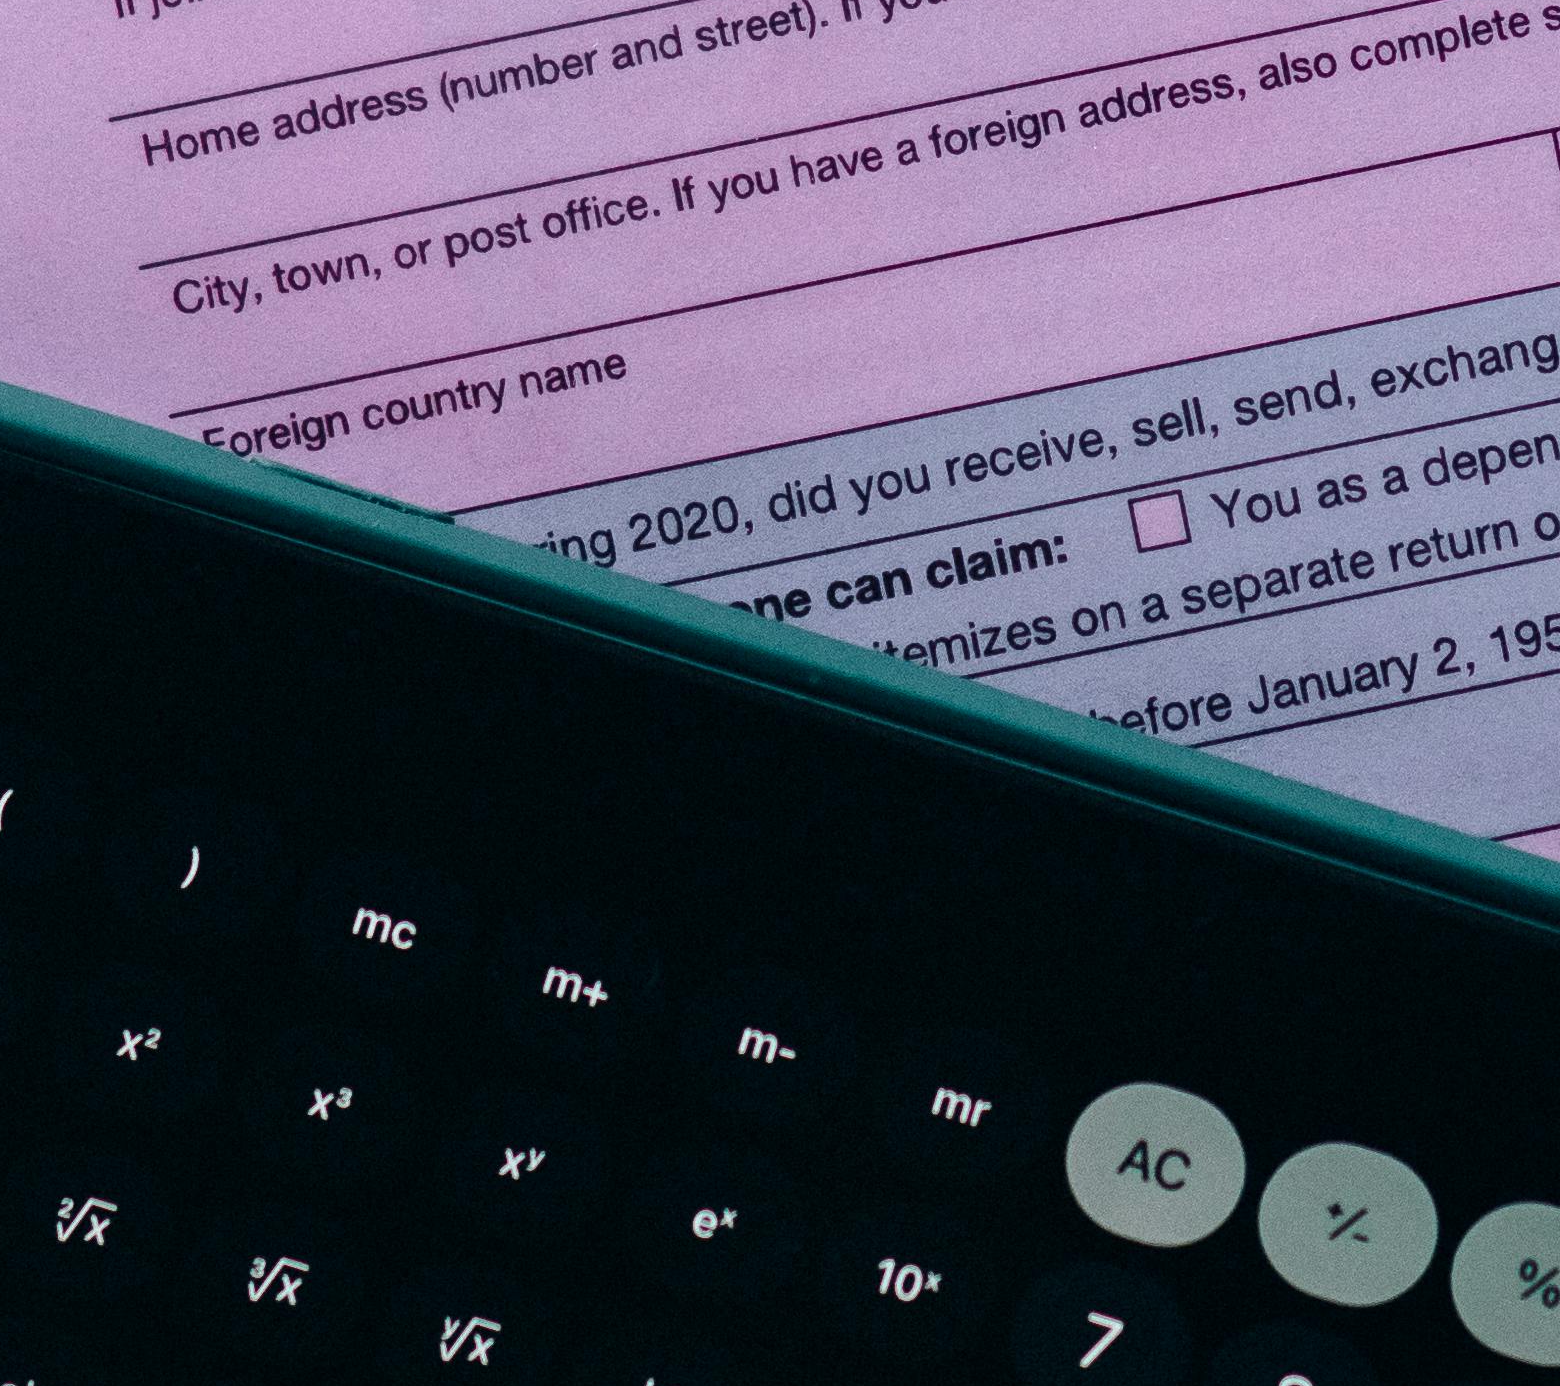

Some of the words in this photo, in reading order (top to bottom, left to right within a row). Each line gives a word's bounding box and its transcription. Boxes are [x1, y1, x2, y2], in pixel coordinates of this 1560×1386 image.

[179, 845, 201, 890] )
[351, 906, 418, 951] mc
[541, 966, 609, 1008] m+
[930, 1087, 993, 1128] mr
[1117, 1139, 1192, 1191] AC
[1079, 1311, 1125, 1369] 7
